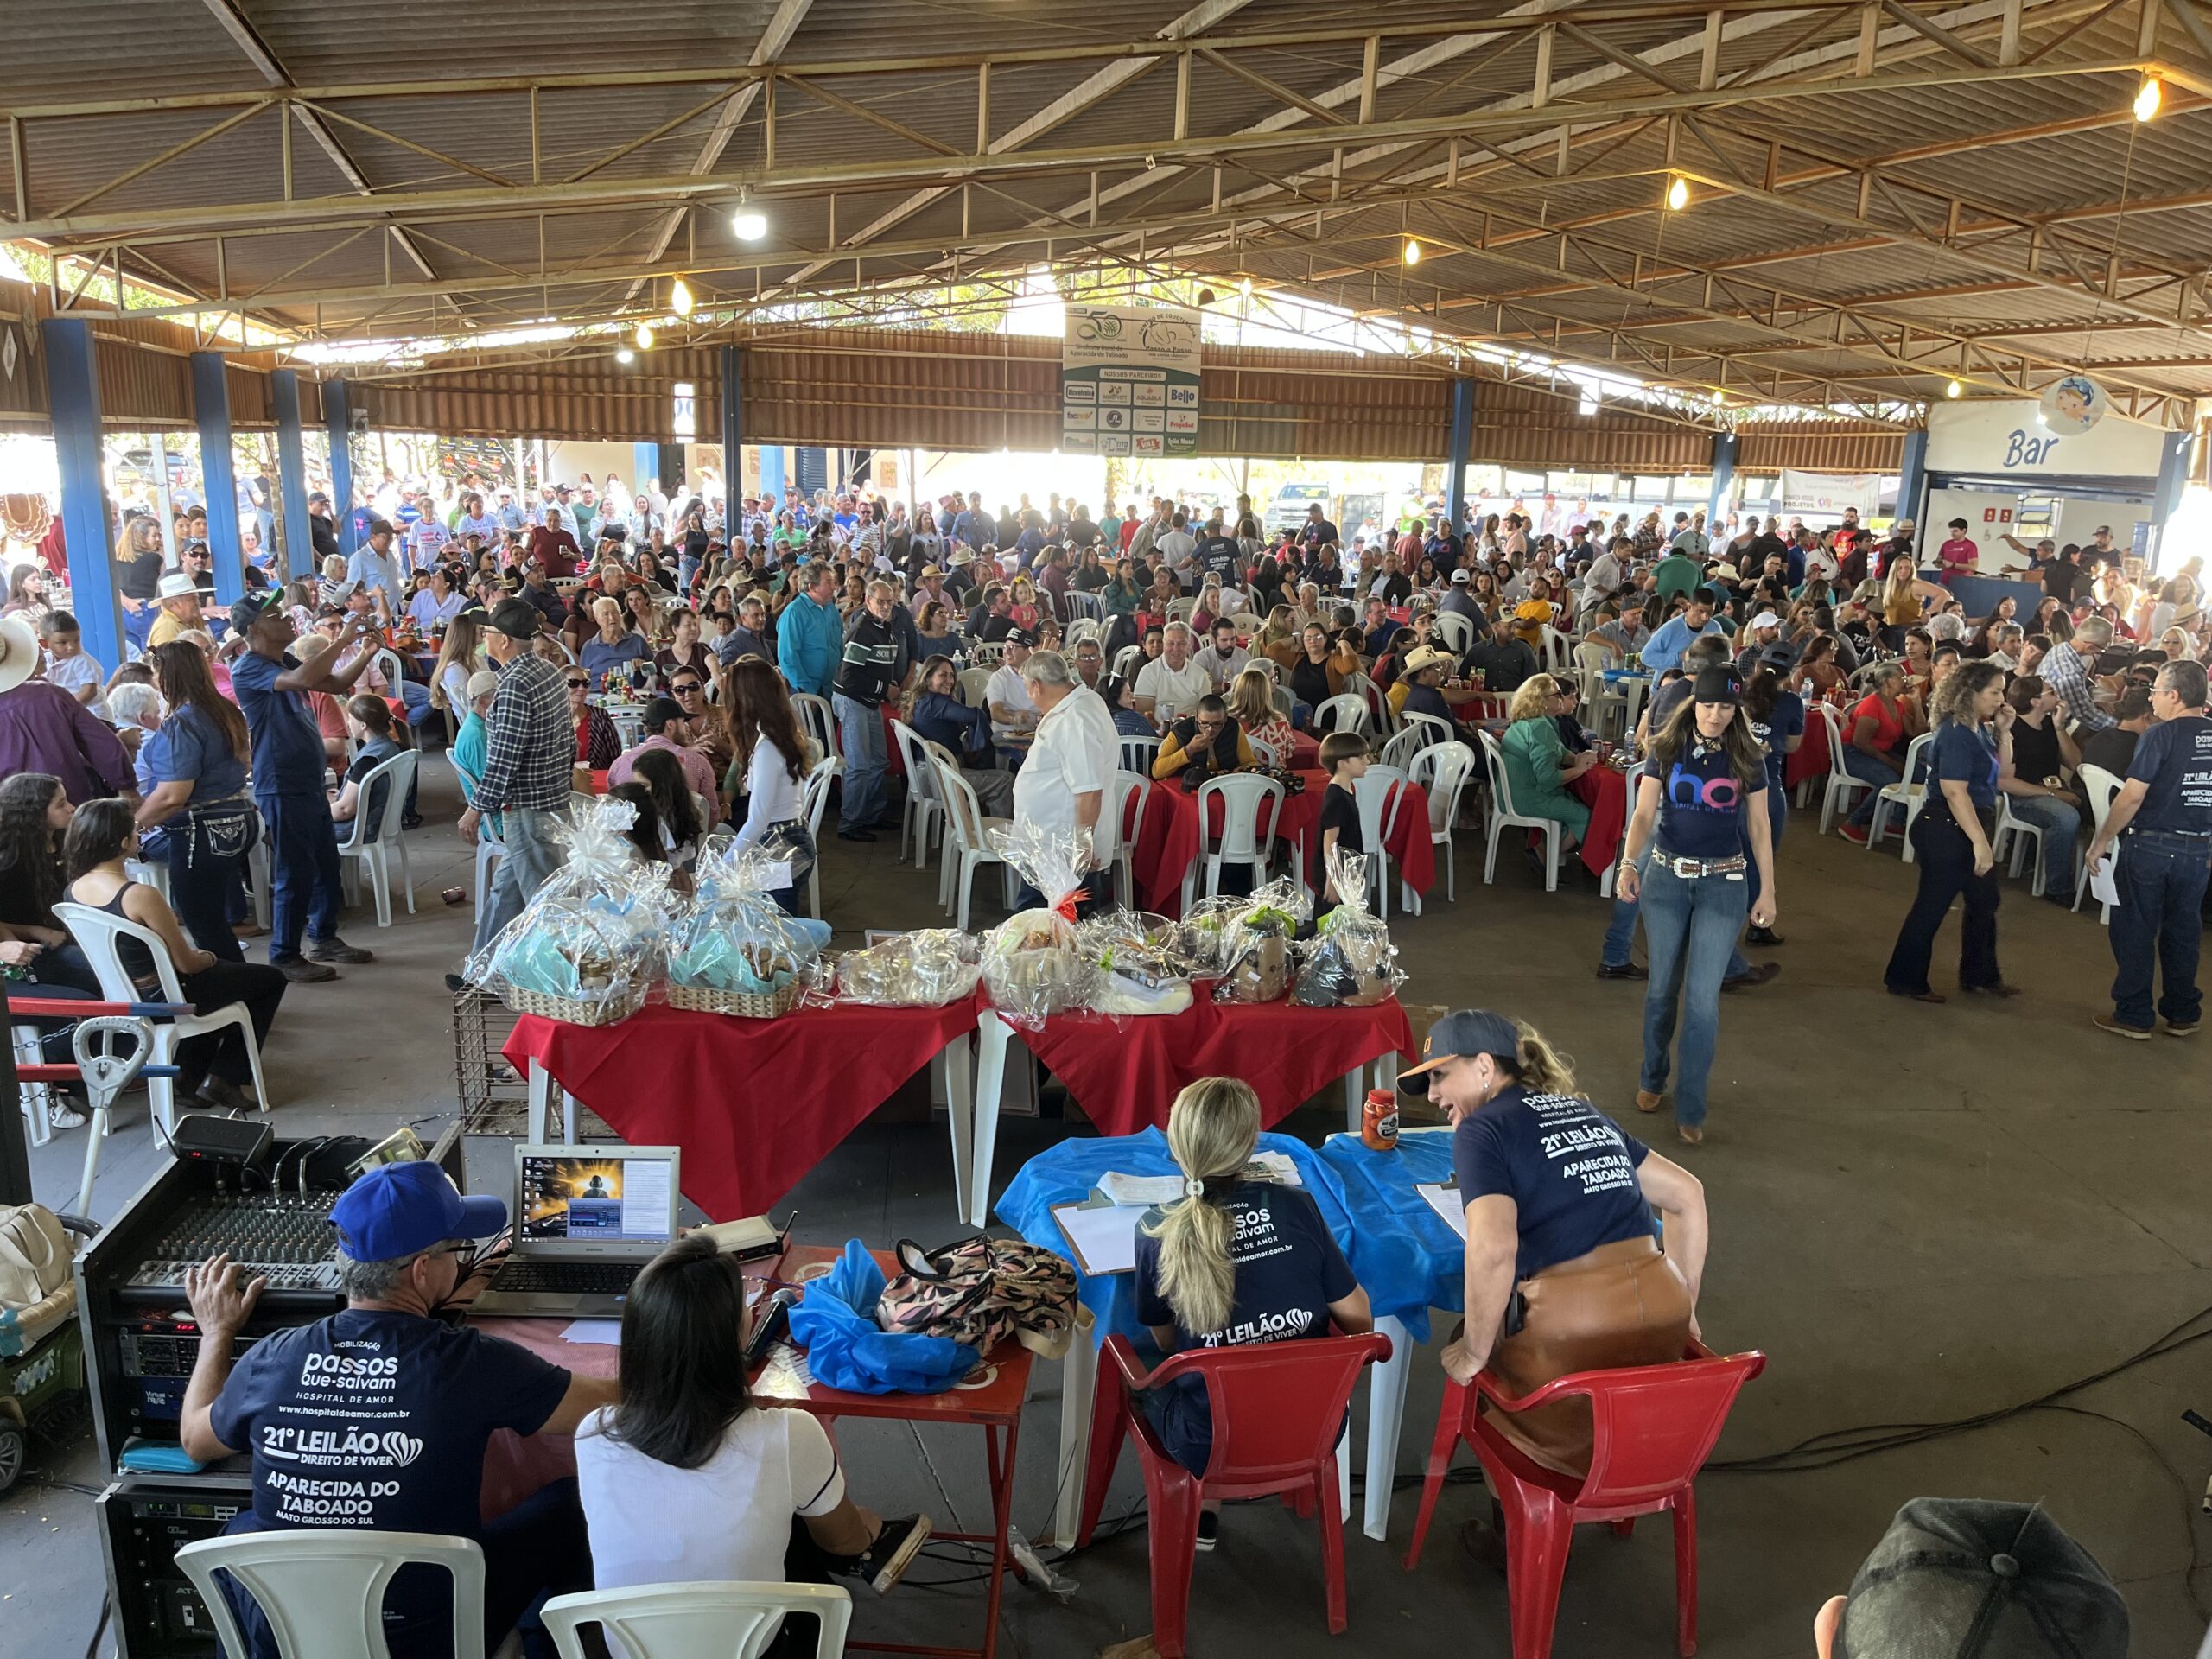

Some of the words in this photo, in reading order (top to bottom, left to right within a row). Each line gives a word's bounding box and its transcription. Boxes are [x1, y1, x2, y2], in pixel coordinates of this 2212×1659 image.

[1171, 389, 1195, 404] Bello
[2003, 429, 2059, 468] Bar
[1562, 1125, 1606, 1145] LEILÃO
[1575, 1142, 1597, 1152] DIREITO
[1563, 1155, 1620, 1179] APARECIDA
[1621, 1154, 1630, 1167] DO
[1580, 1167, 1630, 1186] TABOADO
[1584, 1185, 1600, 1194] MATO
[1600, 1181, 1621, 1191] GROSSO
[1243, 1242, 1254, 1250] DE
[1257, 1236, 1278, 1247] AMOR
[1226, 1313, 1286, 1344] LEILÃO
[1264, 1335, 1274, 1344] DE
[1274, 1328, 1298, 1341] VIVER
[334, 1340, 381, 1351] MOBILIZAÇÃO
[302, 1351, 398, 1376] passos
[296, 1392, 345, 1402] HOSPITAL
[278, 1405, 410, 1419] www.hospitaldeamor.com.br
[297, 1426, 380, 1454] LEILÃO
[300, 1454, 342, 1466] DIREITO
[344, 1456, 358, 1466] DE
[360, 1456, 393, 1466] VIVER
[266, 1471, 365, 1497] APARECIDA
[370, 1481, 400, 1497] DO
[282, 1494, 373, 1515] TABOADO
[276, 1510, 300, 1523] MATO
[302, 1516, 340, 1525] GROSSO
[342, 1516, 356, 1525] DO
[358, 1516, 374, 1525] SUL
